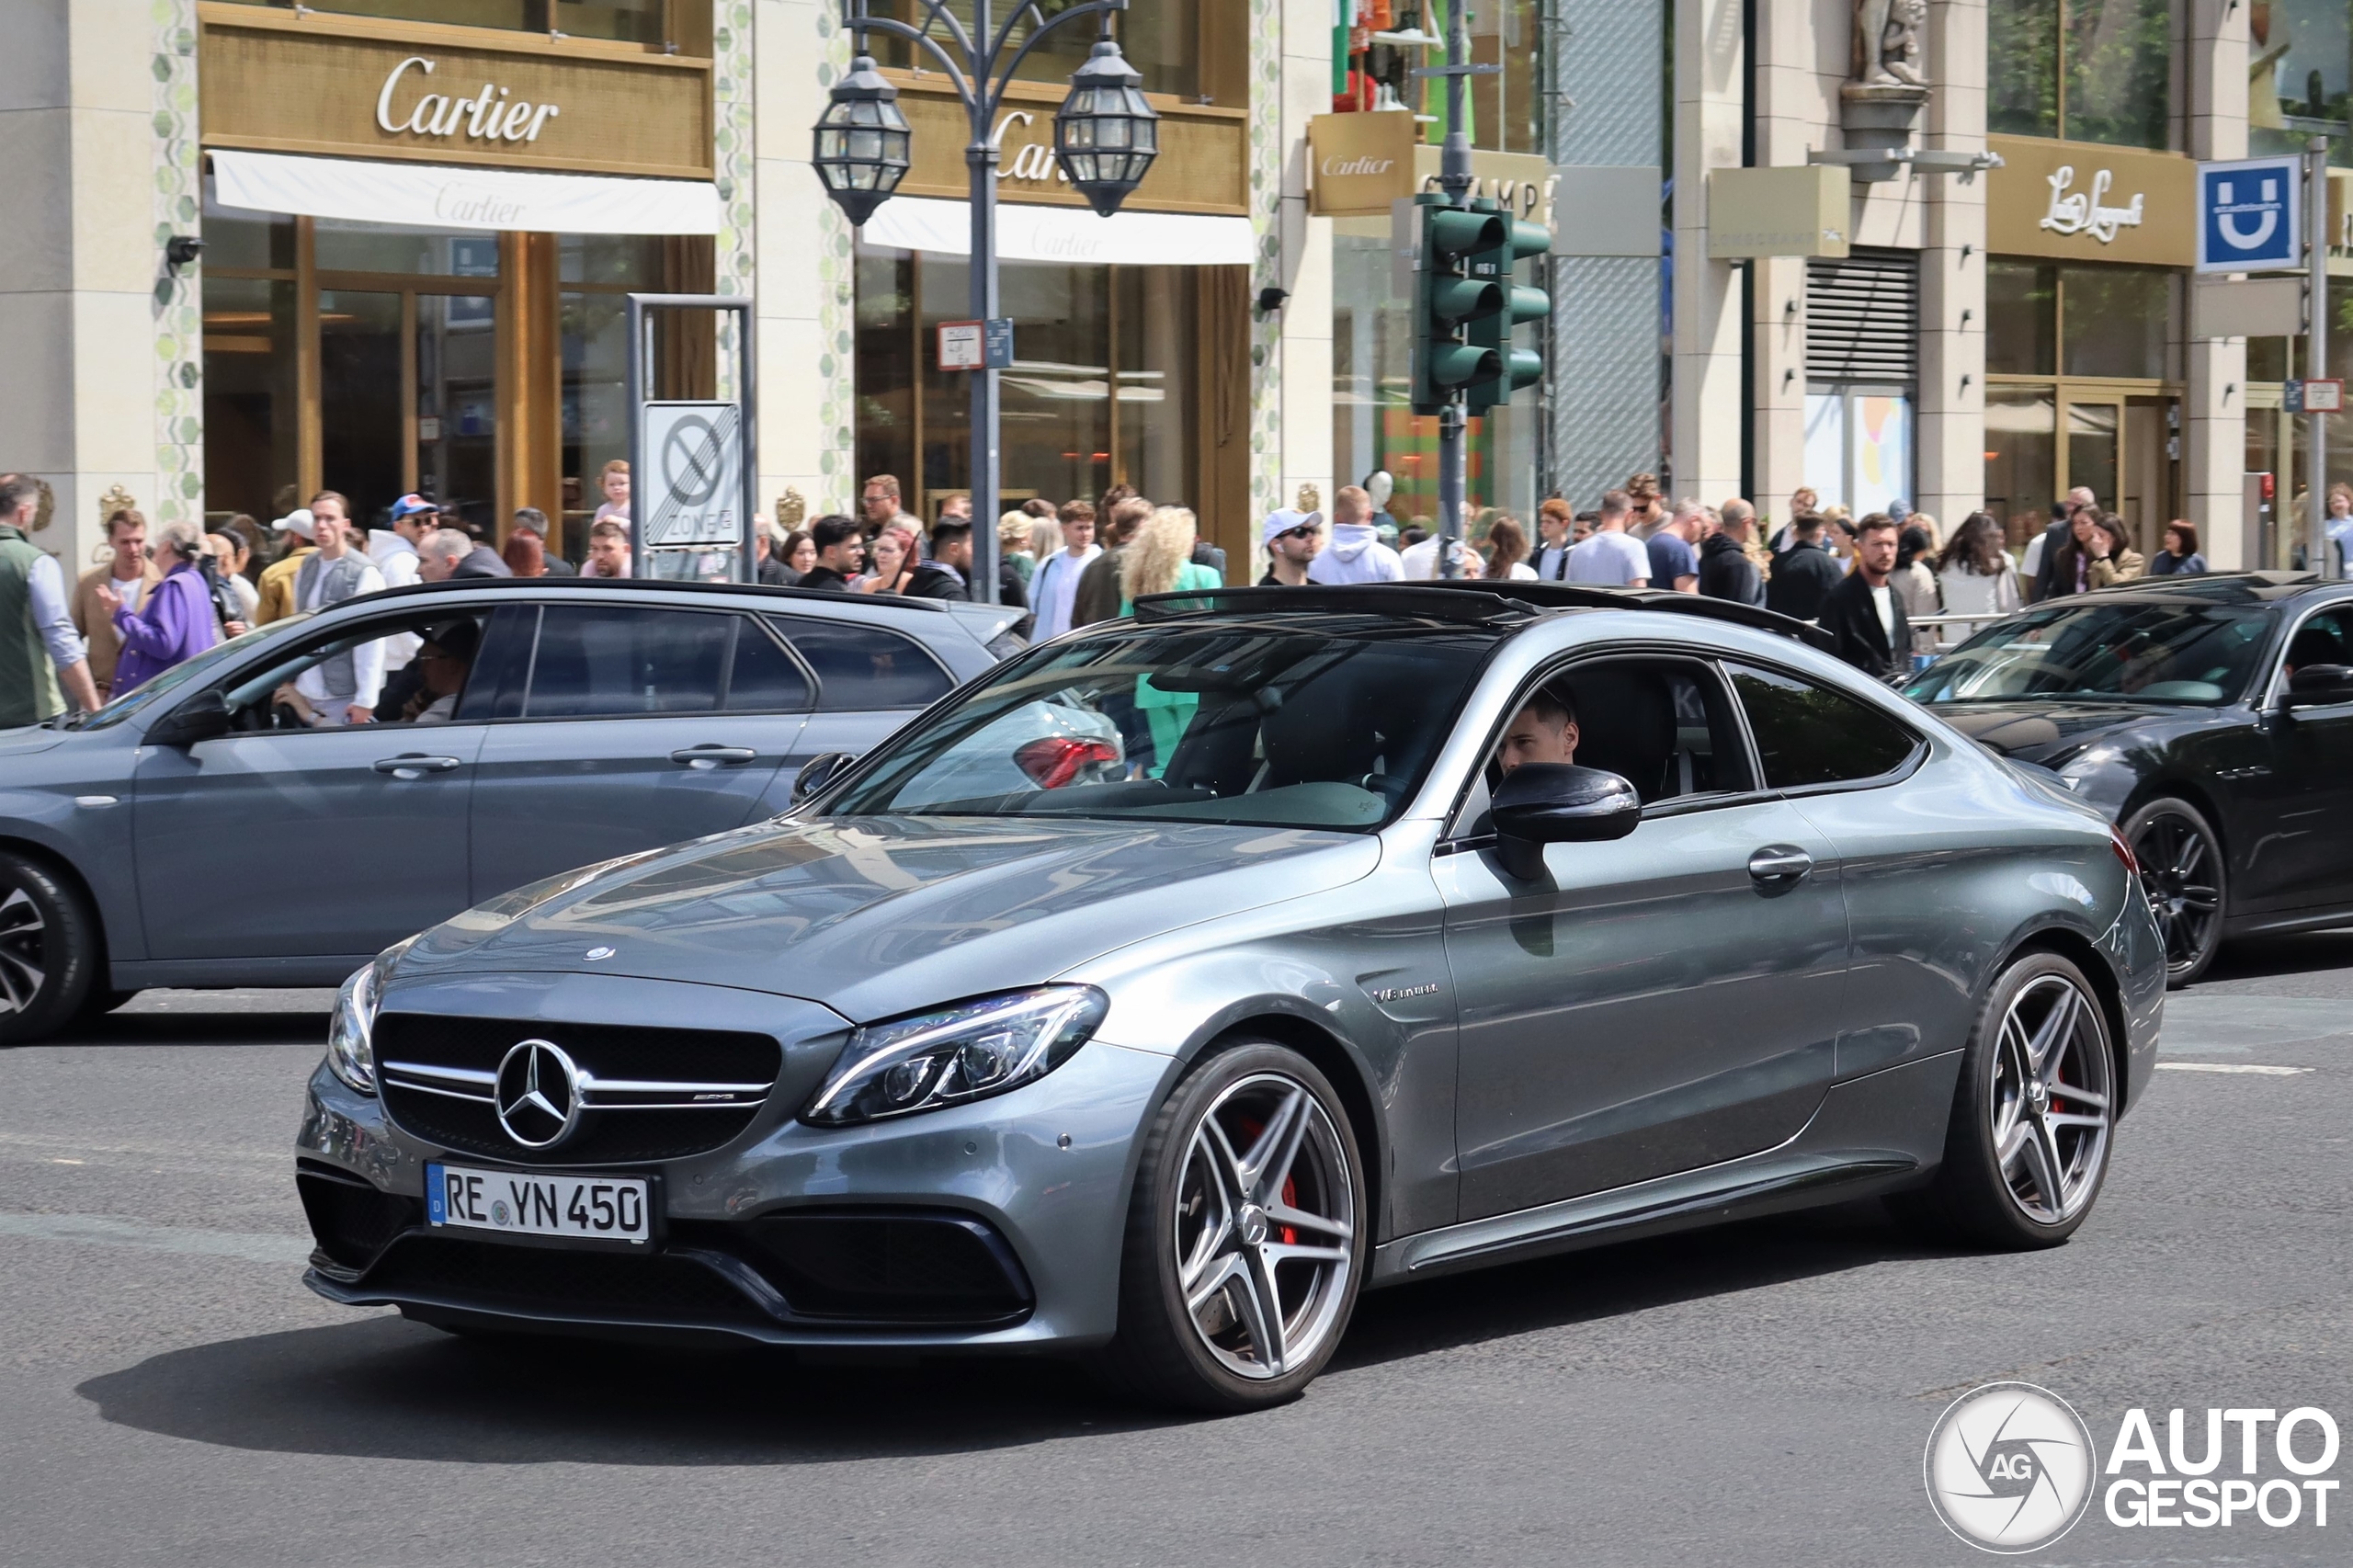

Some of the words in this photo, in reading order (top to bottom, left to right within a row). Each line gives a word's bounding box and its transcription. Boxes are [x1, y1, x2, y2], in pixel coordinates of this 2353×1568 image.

[377, 57, 559, 141] Cartier
[1322, 154, 1393, 176] Cartier
[435, 181, 527, 223] Cartier
[1031, 219, 1103, 256] Cartier
[669, 514, 717, 536] ZONE
[447, 1174, 487, 1222] RE
[510, 1181, 558, 1228] YN
[568, 1185, 642, 1232] 450
